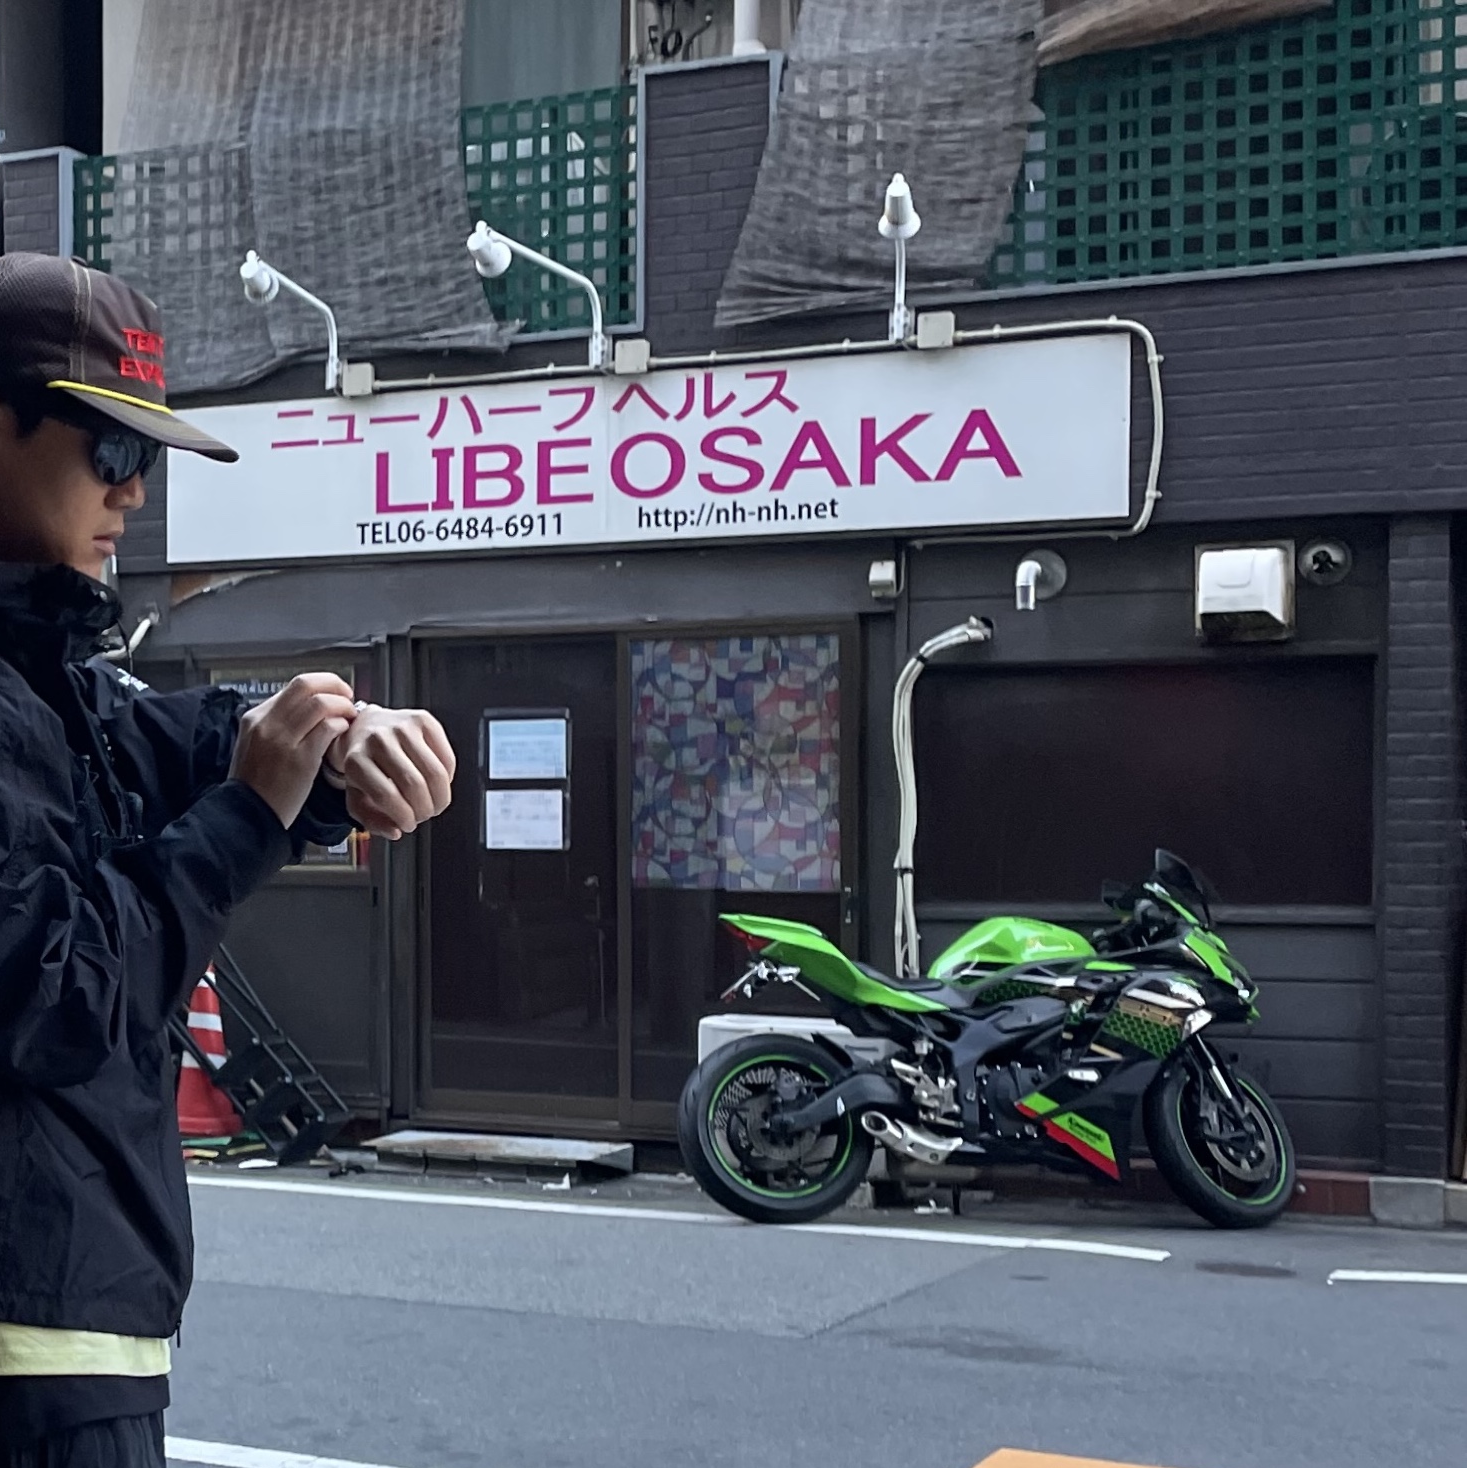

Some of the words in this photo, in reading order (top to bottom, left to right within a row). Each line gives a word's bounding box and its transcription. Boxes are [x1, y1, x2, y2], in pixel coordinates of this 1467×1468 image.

[271, 369, 800, 449] ニューハーフヘルス
[375, 437, 595, 514] LIBE
[609, 408, 1022, 500] OSAKA
[356, 512, 563, 546] TEL06-6484-6911
[637, 497, 840, 533] http://nh-nh.net
